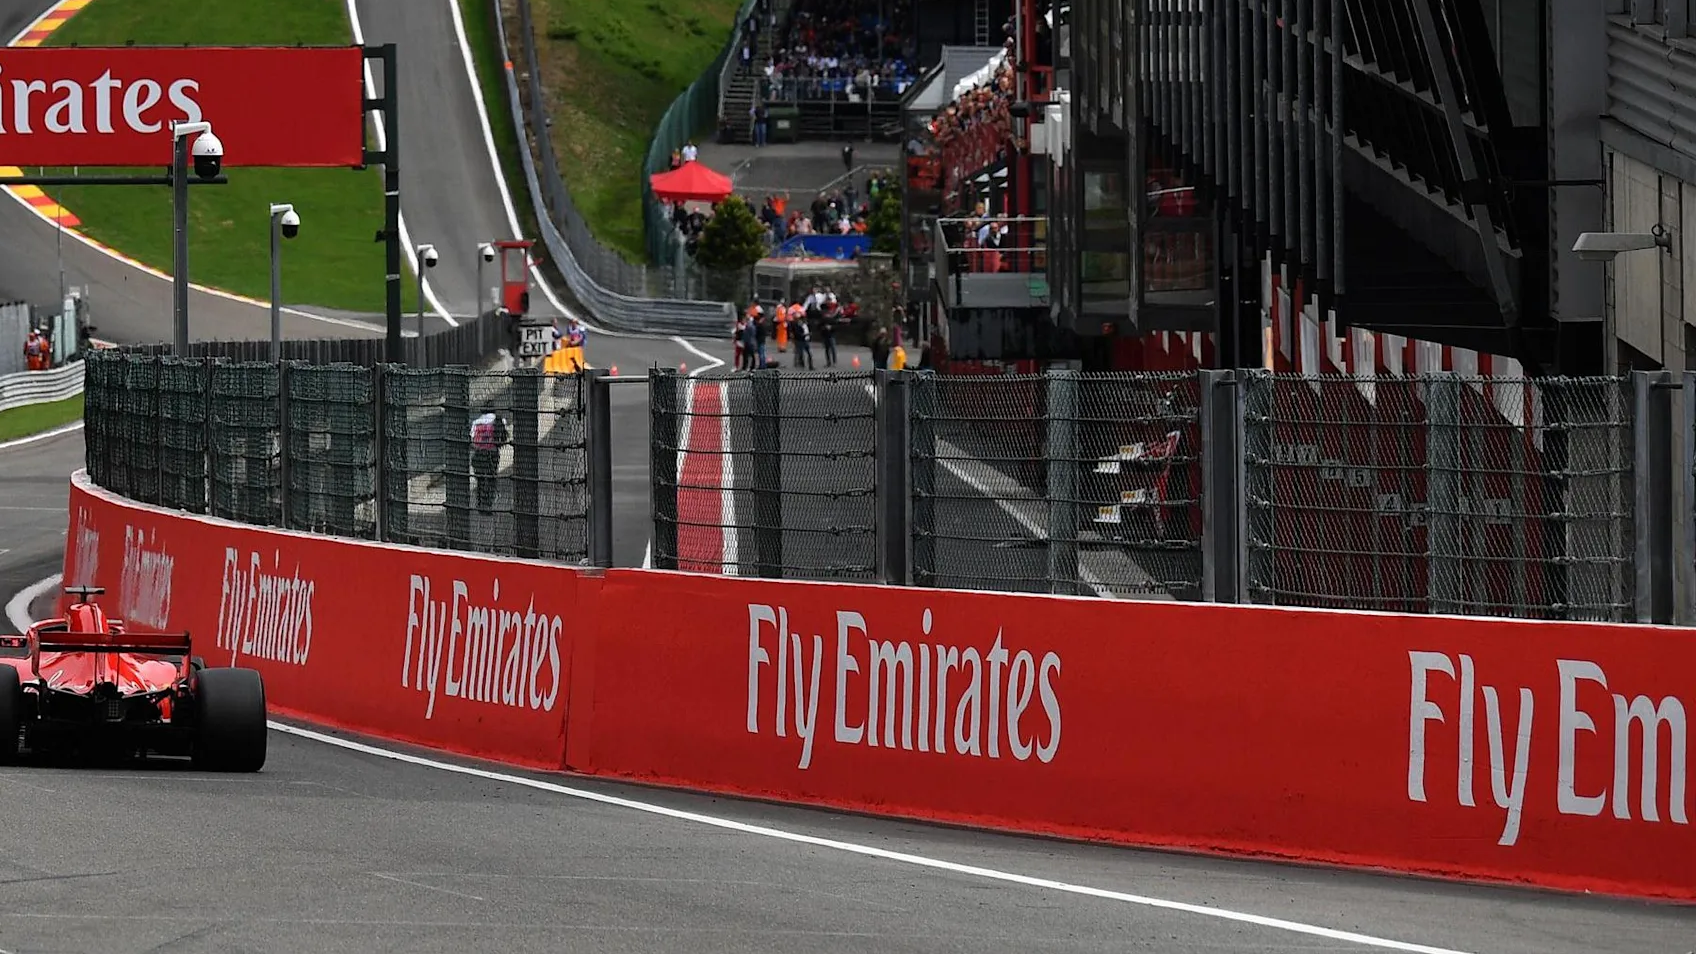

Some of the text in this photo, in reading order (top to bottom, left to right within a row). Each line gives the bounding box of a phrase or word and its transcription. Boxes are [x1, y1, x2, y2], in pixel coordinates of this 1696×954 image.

[524, 342, 548, 353] EXIT
[217, 547, 247, 668] Fly
[242, 548, 315, 666] Emirates
[403, 574, 562, 719] Fly Emirates
[747, 604, 1062, 770] Fly Emirates
[1408, 650, 1534, 846] Fly
